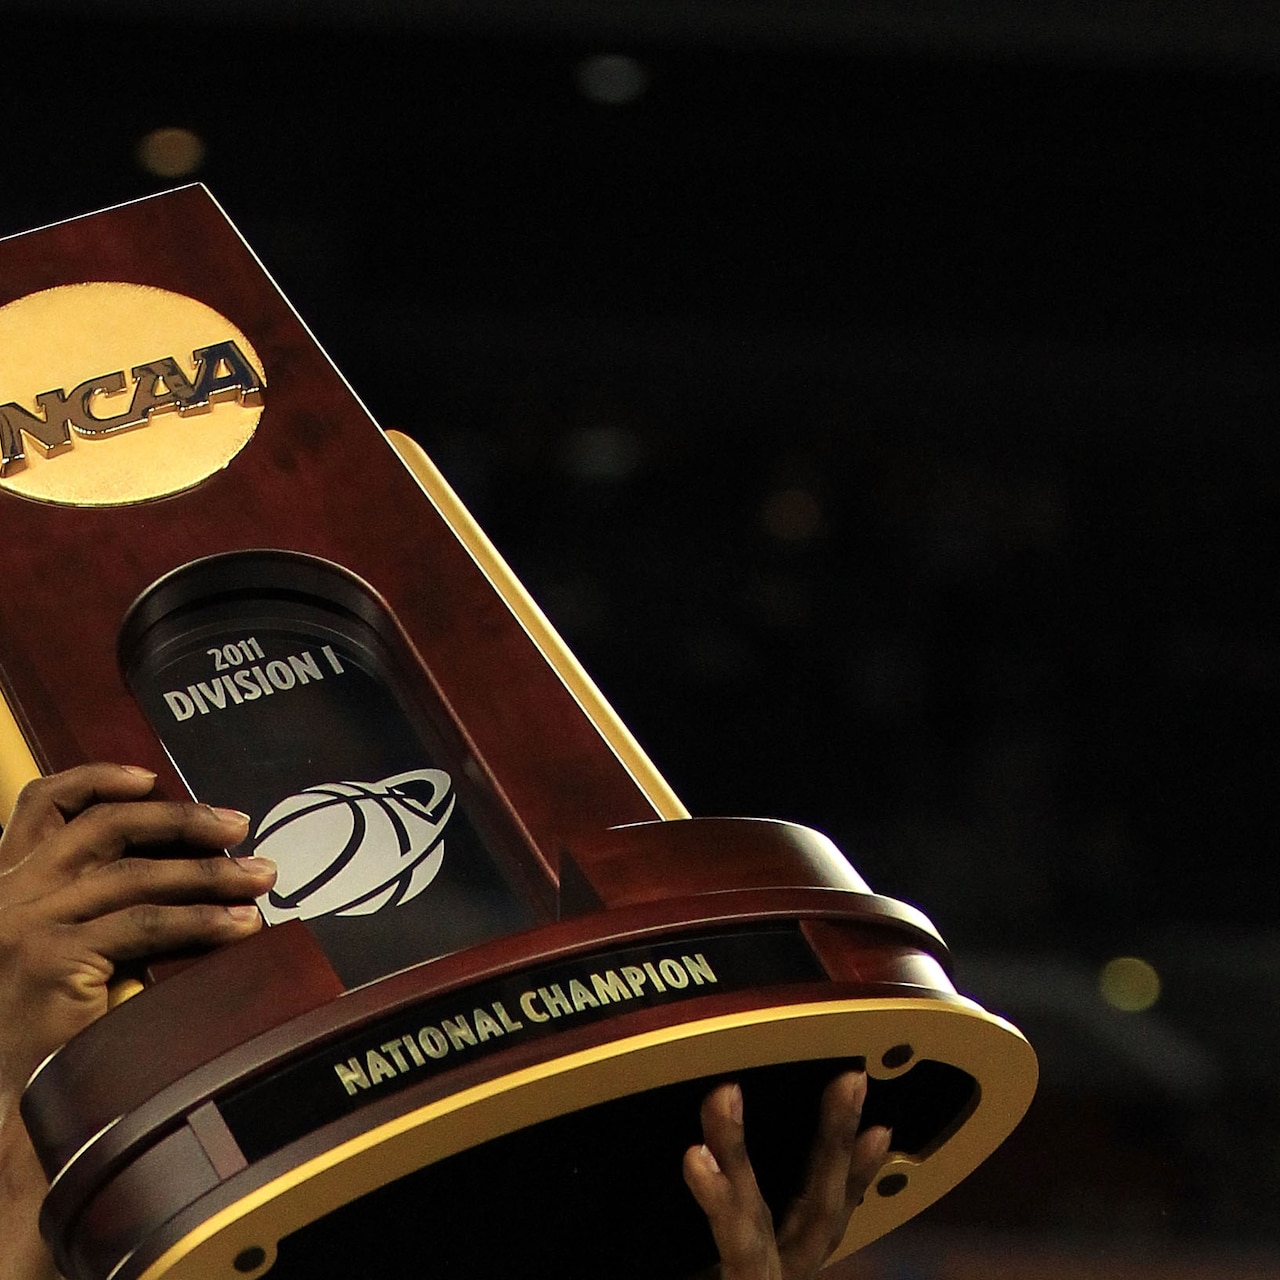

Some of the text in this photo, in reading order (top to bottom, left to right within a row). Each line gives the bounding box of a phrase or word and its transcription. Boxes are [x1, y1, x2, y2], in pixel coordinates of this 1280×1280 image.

[163, 645, 345, 722] DIVISION I
[207, 637, 265, 671] 2011
[334, 953, 718, 1096] NATIONAL CHAMPION
